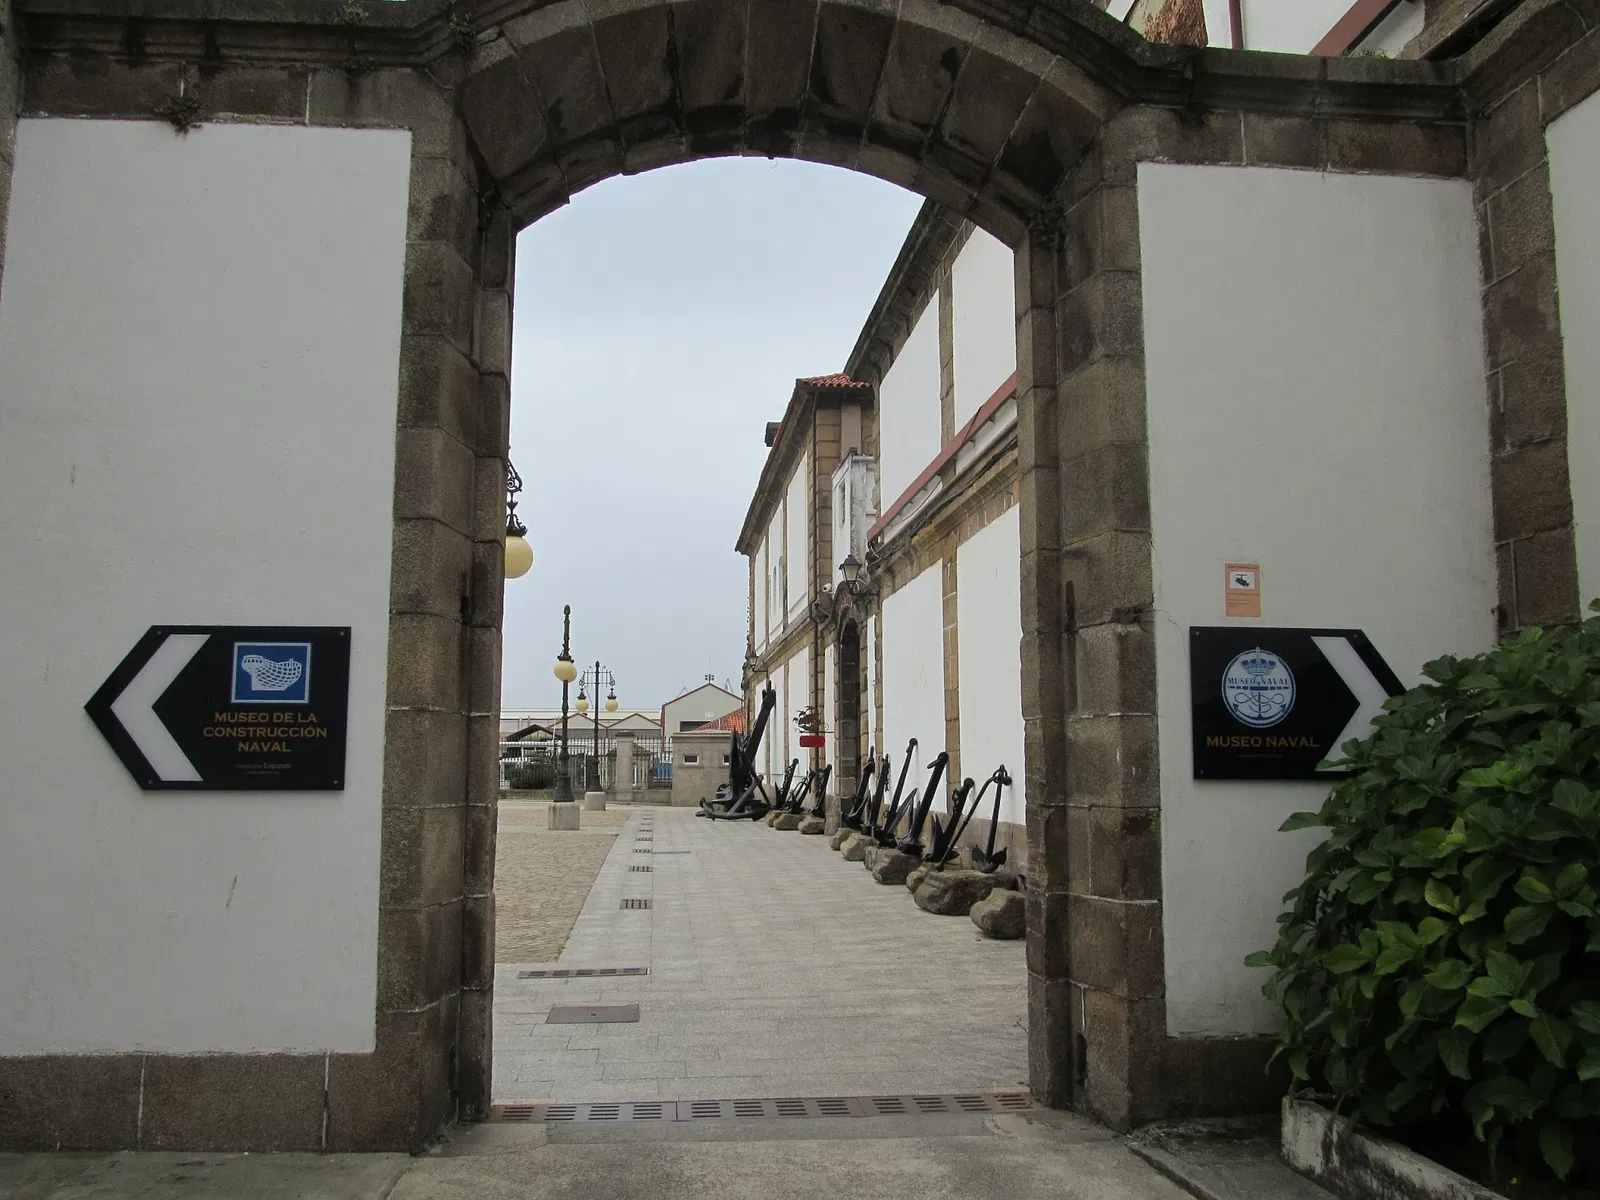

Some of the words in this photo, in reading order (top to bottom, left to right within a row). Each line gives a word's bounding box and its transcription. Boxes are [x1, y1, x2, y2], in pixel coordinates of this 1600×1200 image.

[1228, 677, 1256, 685] MUSEO
[1261, 677, 1290, 685] NAVAL
[214, 712, 269, 723] MUSEO
[273, 712, 294, 723] DE
[297, 712, 317, 723] LA
[203, 725, 328, 738] CONSTRUCCIÓN
[238, 742, 292, 752] NAVAL
[1206, 736, 1262, 748] MUSEO
[1266, 736, 1321, 748] NAVAL
